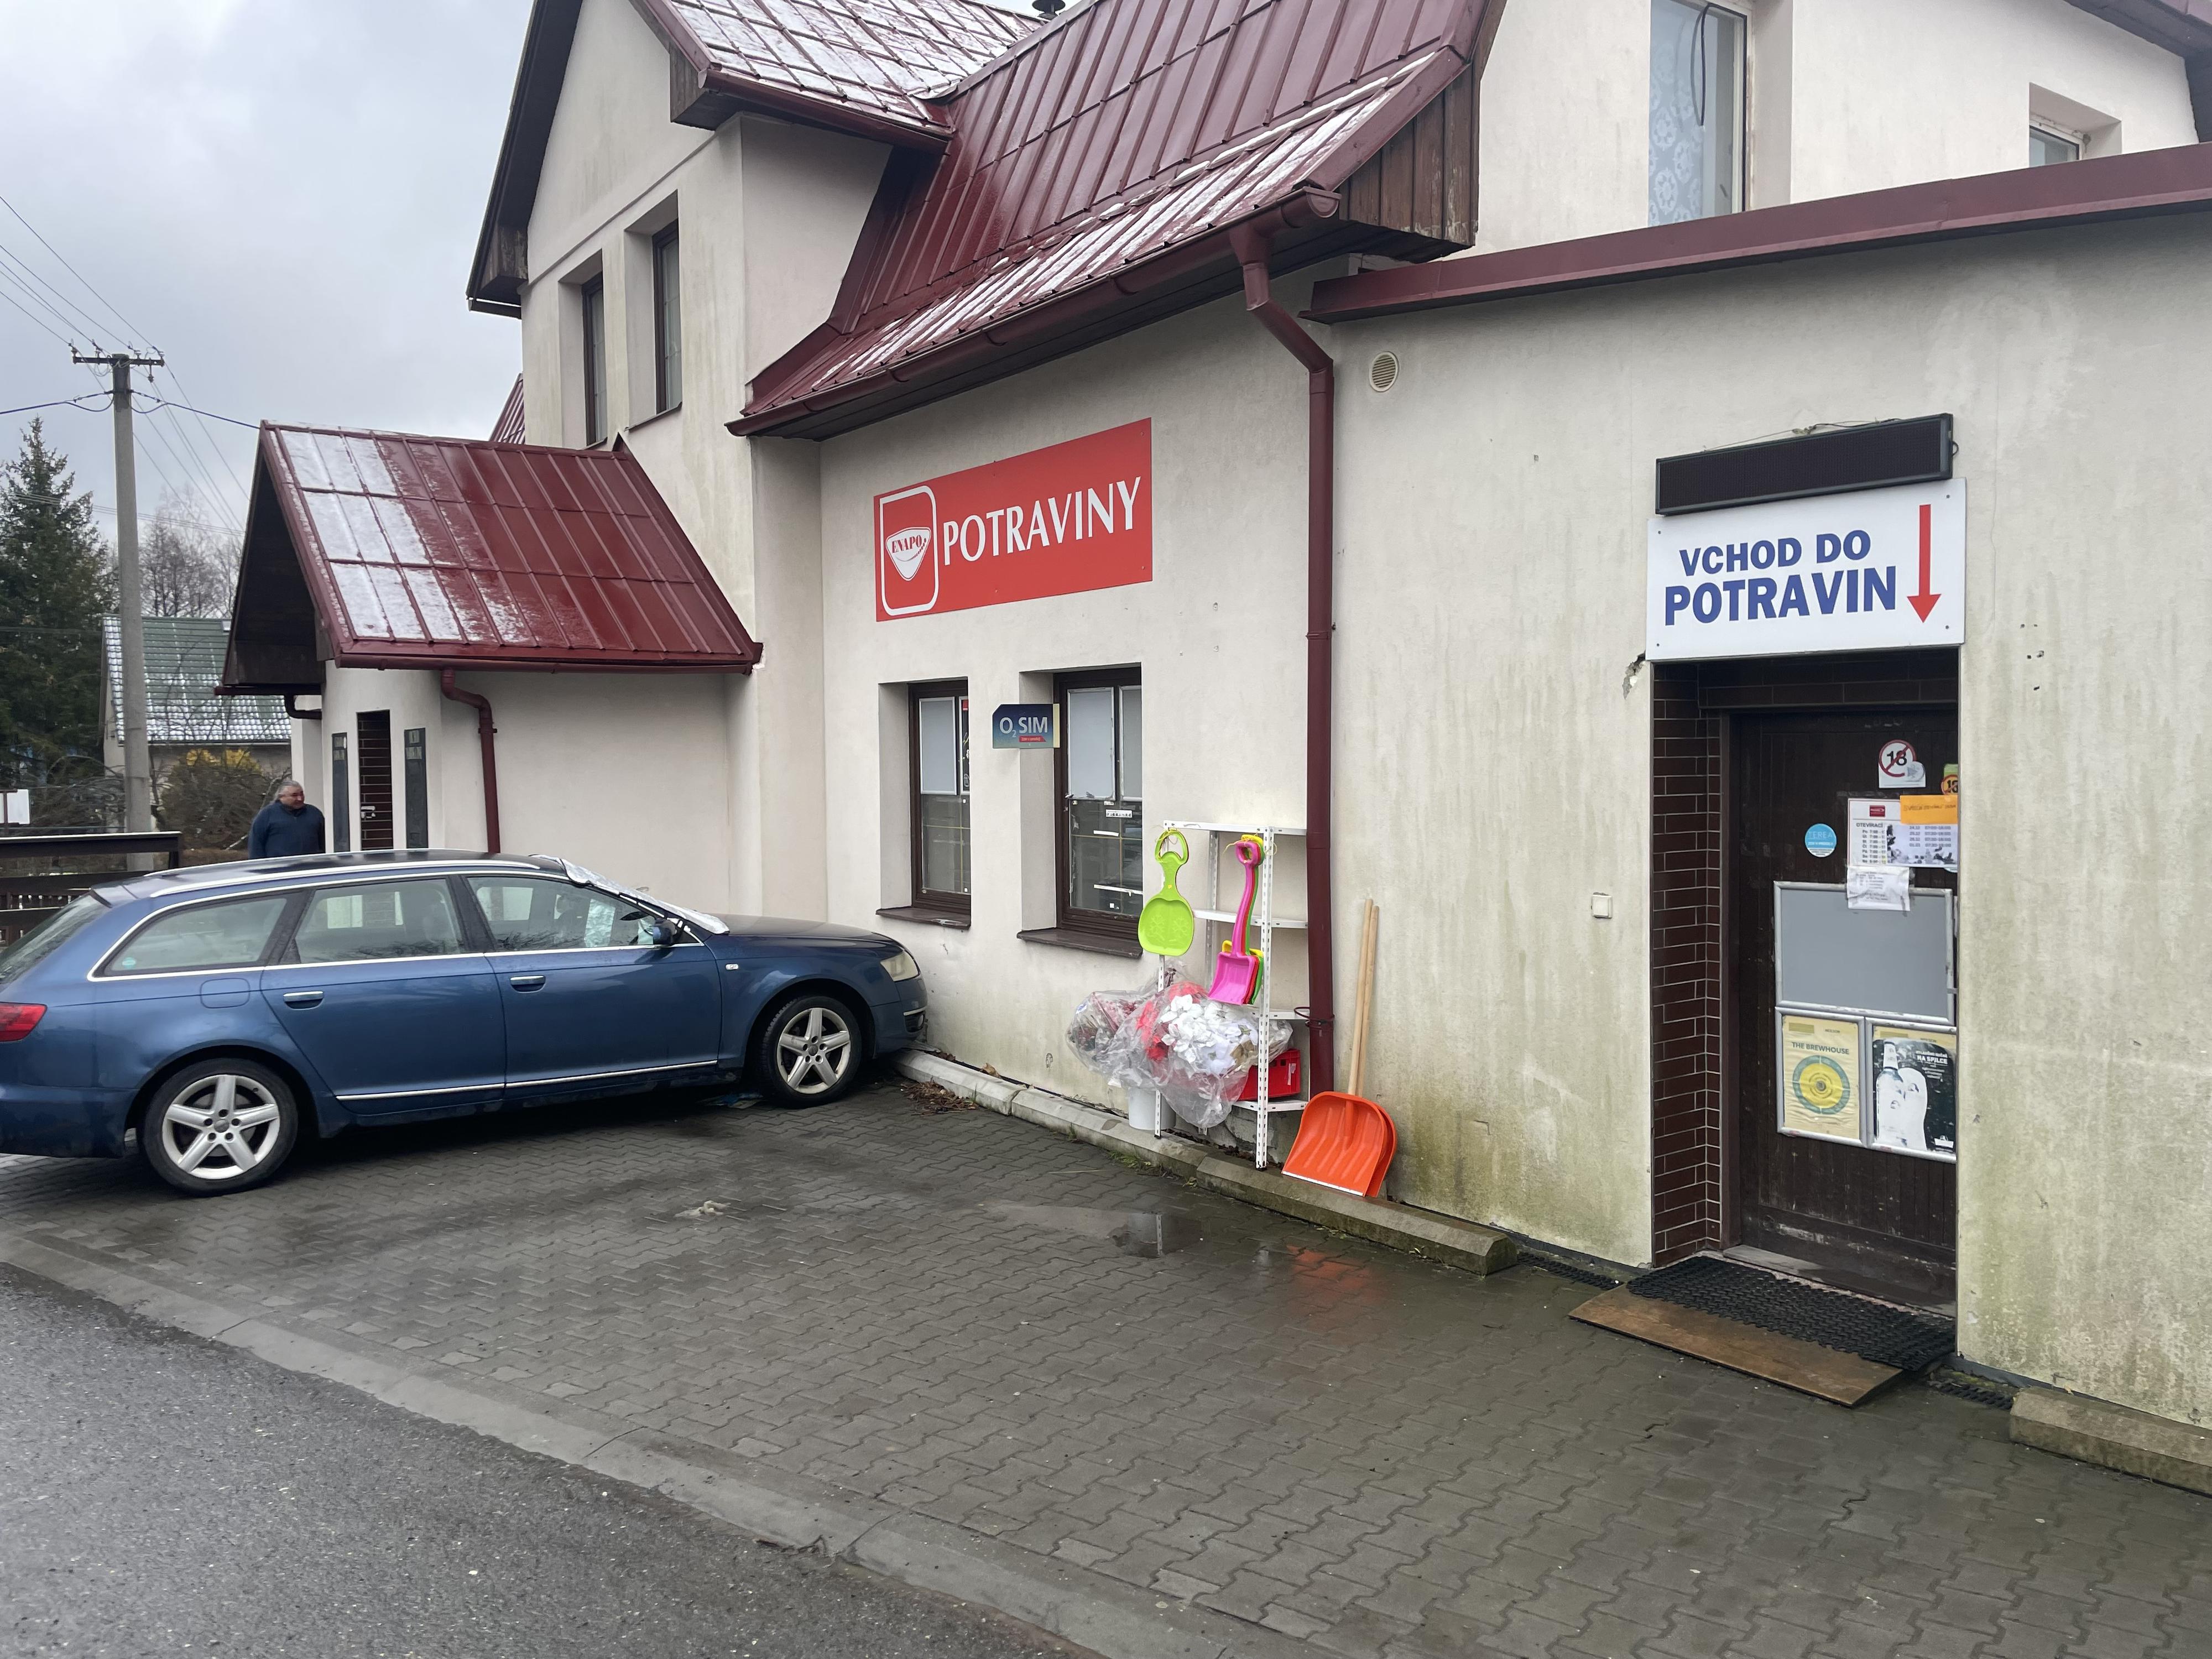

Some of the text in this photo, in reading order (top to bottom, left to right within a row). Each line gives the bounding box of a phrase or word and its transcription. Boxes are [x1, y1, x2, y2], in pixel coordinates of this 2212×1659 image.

[943, 476, 1141, 566] POTRAVINY
[891, 535, 922, 554] ENAPO
[1679, 529, 1871, 576] VCHOD DO
[1665, 566, 1896, 626] POTRAVIN
[1018, 717, 1048, 733] SIM
[1887, 750, 1907, 766] 18
[1806, 1044, 1850, 1055] BREWHOUSE
